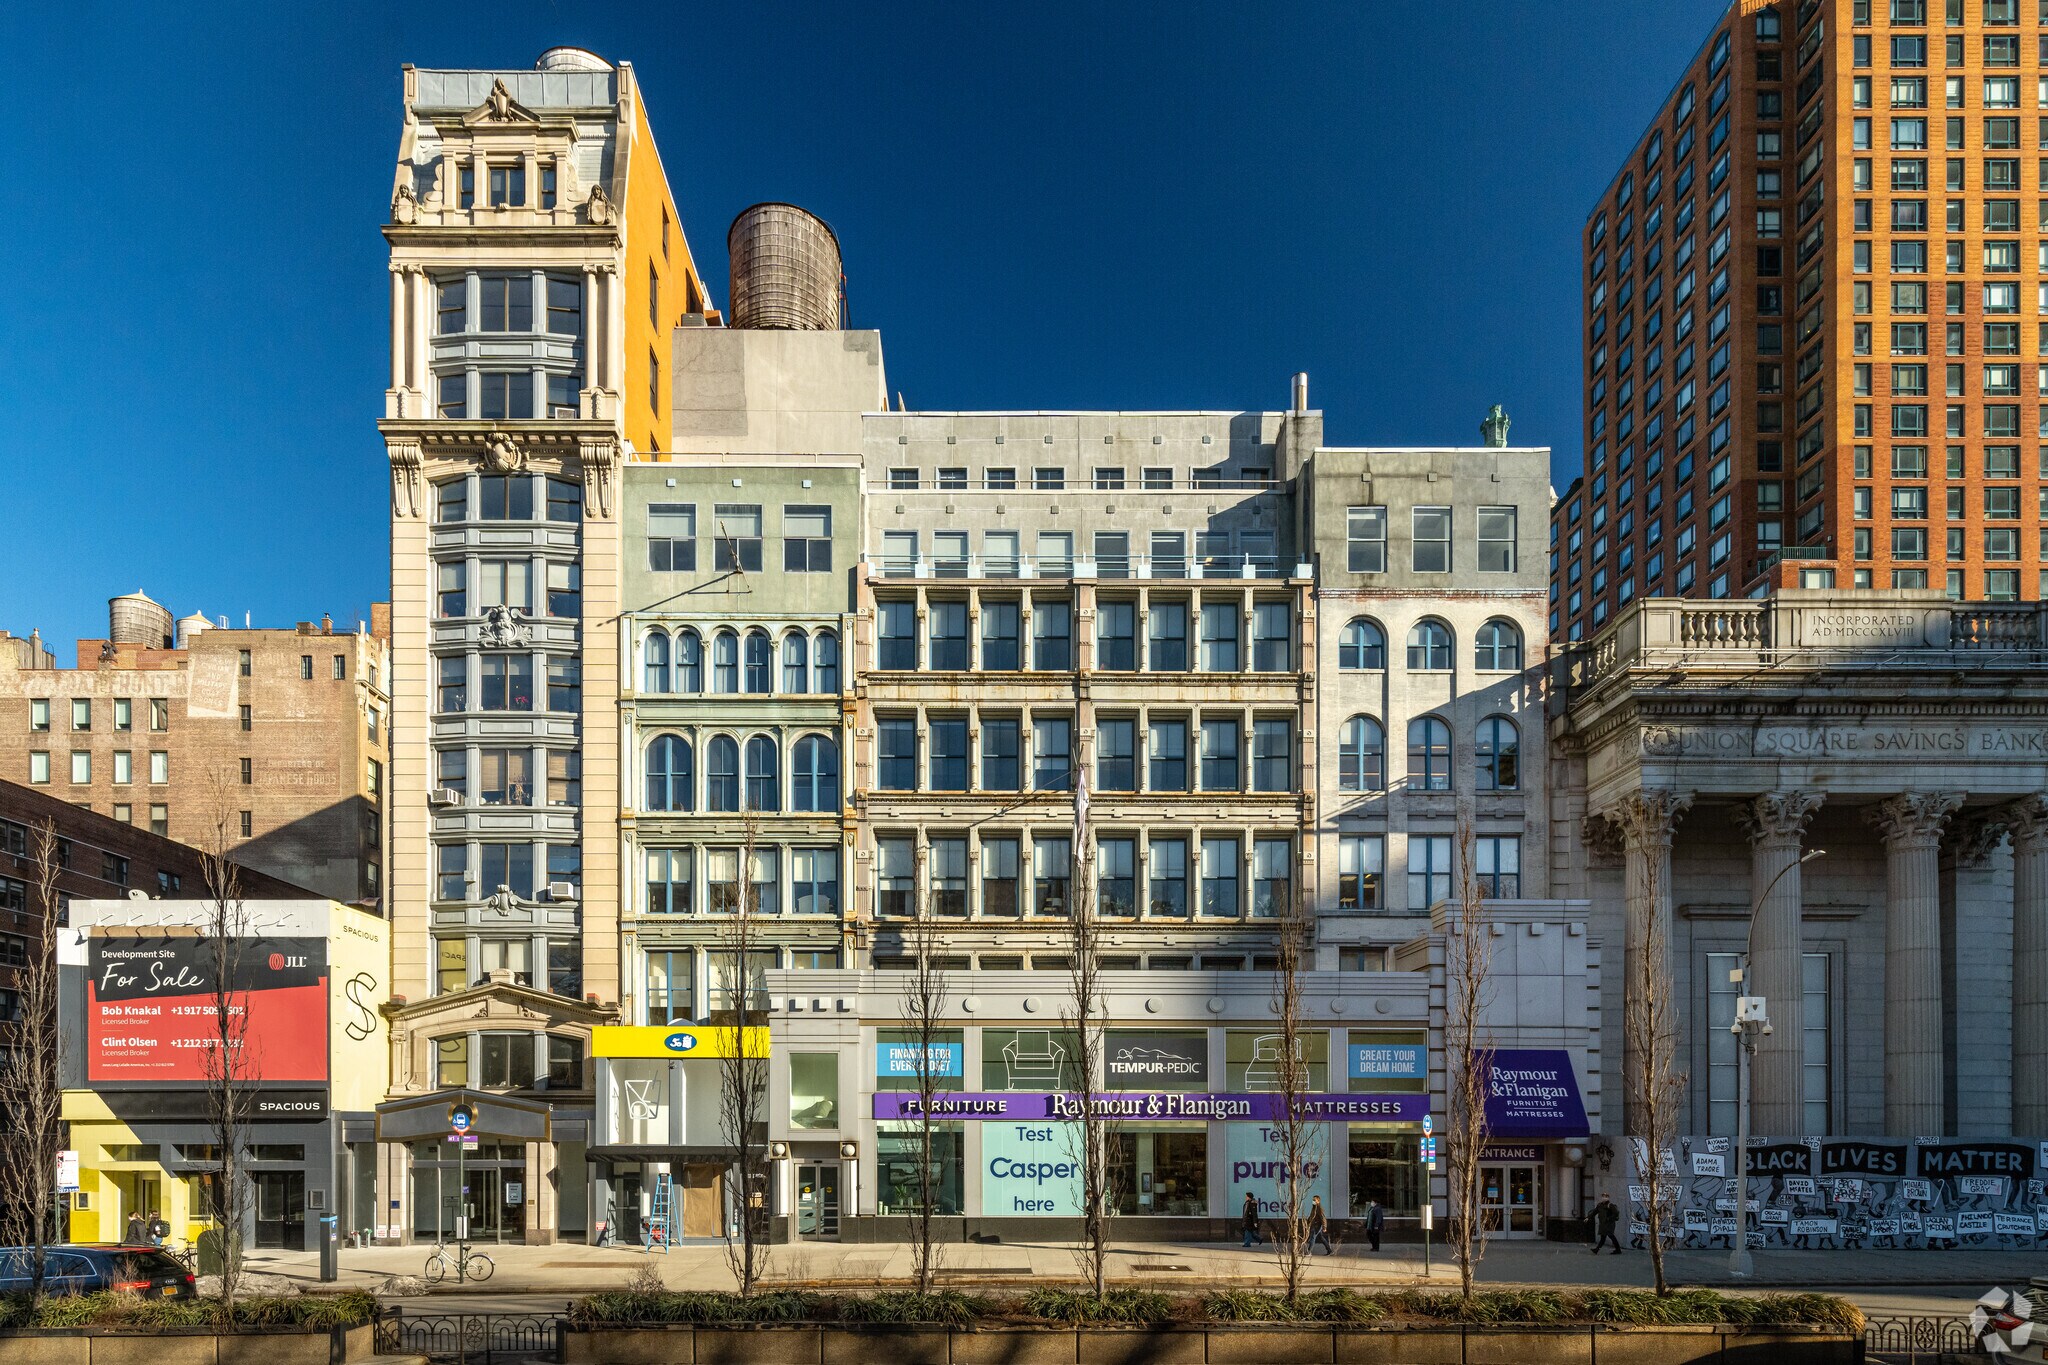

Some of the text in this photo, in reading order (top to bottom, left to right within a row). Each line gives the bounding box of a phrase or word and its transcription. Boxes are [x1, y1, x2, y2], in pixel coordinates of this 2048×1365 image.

[1813, 616, 1914, 625] INCORPORATED
[1680, 733, 2042, 753] UNION SQUARE SAVINGS BANK
[343, 925, 379, 942] SPACIOUS
[102, 950, 176, 959] Development Site
[285, 956, 306, 968] JLL
[101, 962, 204, 991] For Sale
[102, 1006, 161, 1015] Bob Knakal
[171, 1007, 182, 1015] +1
[184, 1007, 201, 1015] 917
[102, 1038, 157, 1047] Clint Olsen
[171, 1039, 182, 1048] +1
[184, 1039, 201, 1048] 212
[1360, 1050, 1416, 1060] CREATE YOUR
[1110, 1063, 1200, 1073] TEMPUR-PEDIC
[1360, 1062, 1415, 1073] DREAM HOME
[1492, 1066, 1557, 1083] Raymour
[1053, 1094, 1144, 1118] Raymour
[1166, 1094, 1251, 1119] Flanigan
[1292, 1102, 1402, 1113] MATTRESSES
[1015, 1127, 1053, 1141] Test
[1259, 1128, 1290, 1142] Tes
[1479, 1149, 1536, 1158] ENTRANCE
[1696, 1157, 1718, 1165] ADAMA
[1746, 1150, 1807, 1171] BLACK
[1827, 1149, 1897, 1171] LIVES
[1925, 1150, 2023, 1171] MATTER
[990, 1157, 1079, 1185] Casper
[1904, 1181, 1927, 1189] MICHAEL
[1965, 1178, 1995, 1186] FREDDIE
[1907, 1189, 1927, 1197] BROWN
[1970, 1185, 1990, 1193] GRAY
[1014, 1196, 1055, 1211] here
[1258, 1198, 1290, 1213] her
[1902, 1212, 1916, 1220] PAUL
[1997, 1215, 2033, 1223] TERRANCE
[1959, 1221, 1987, 1229] CASTILE
